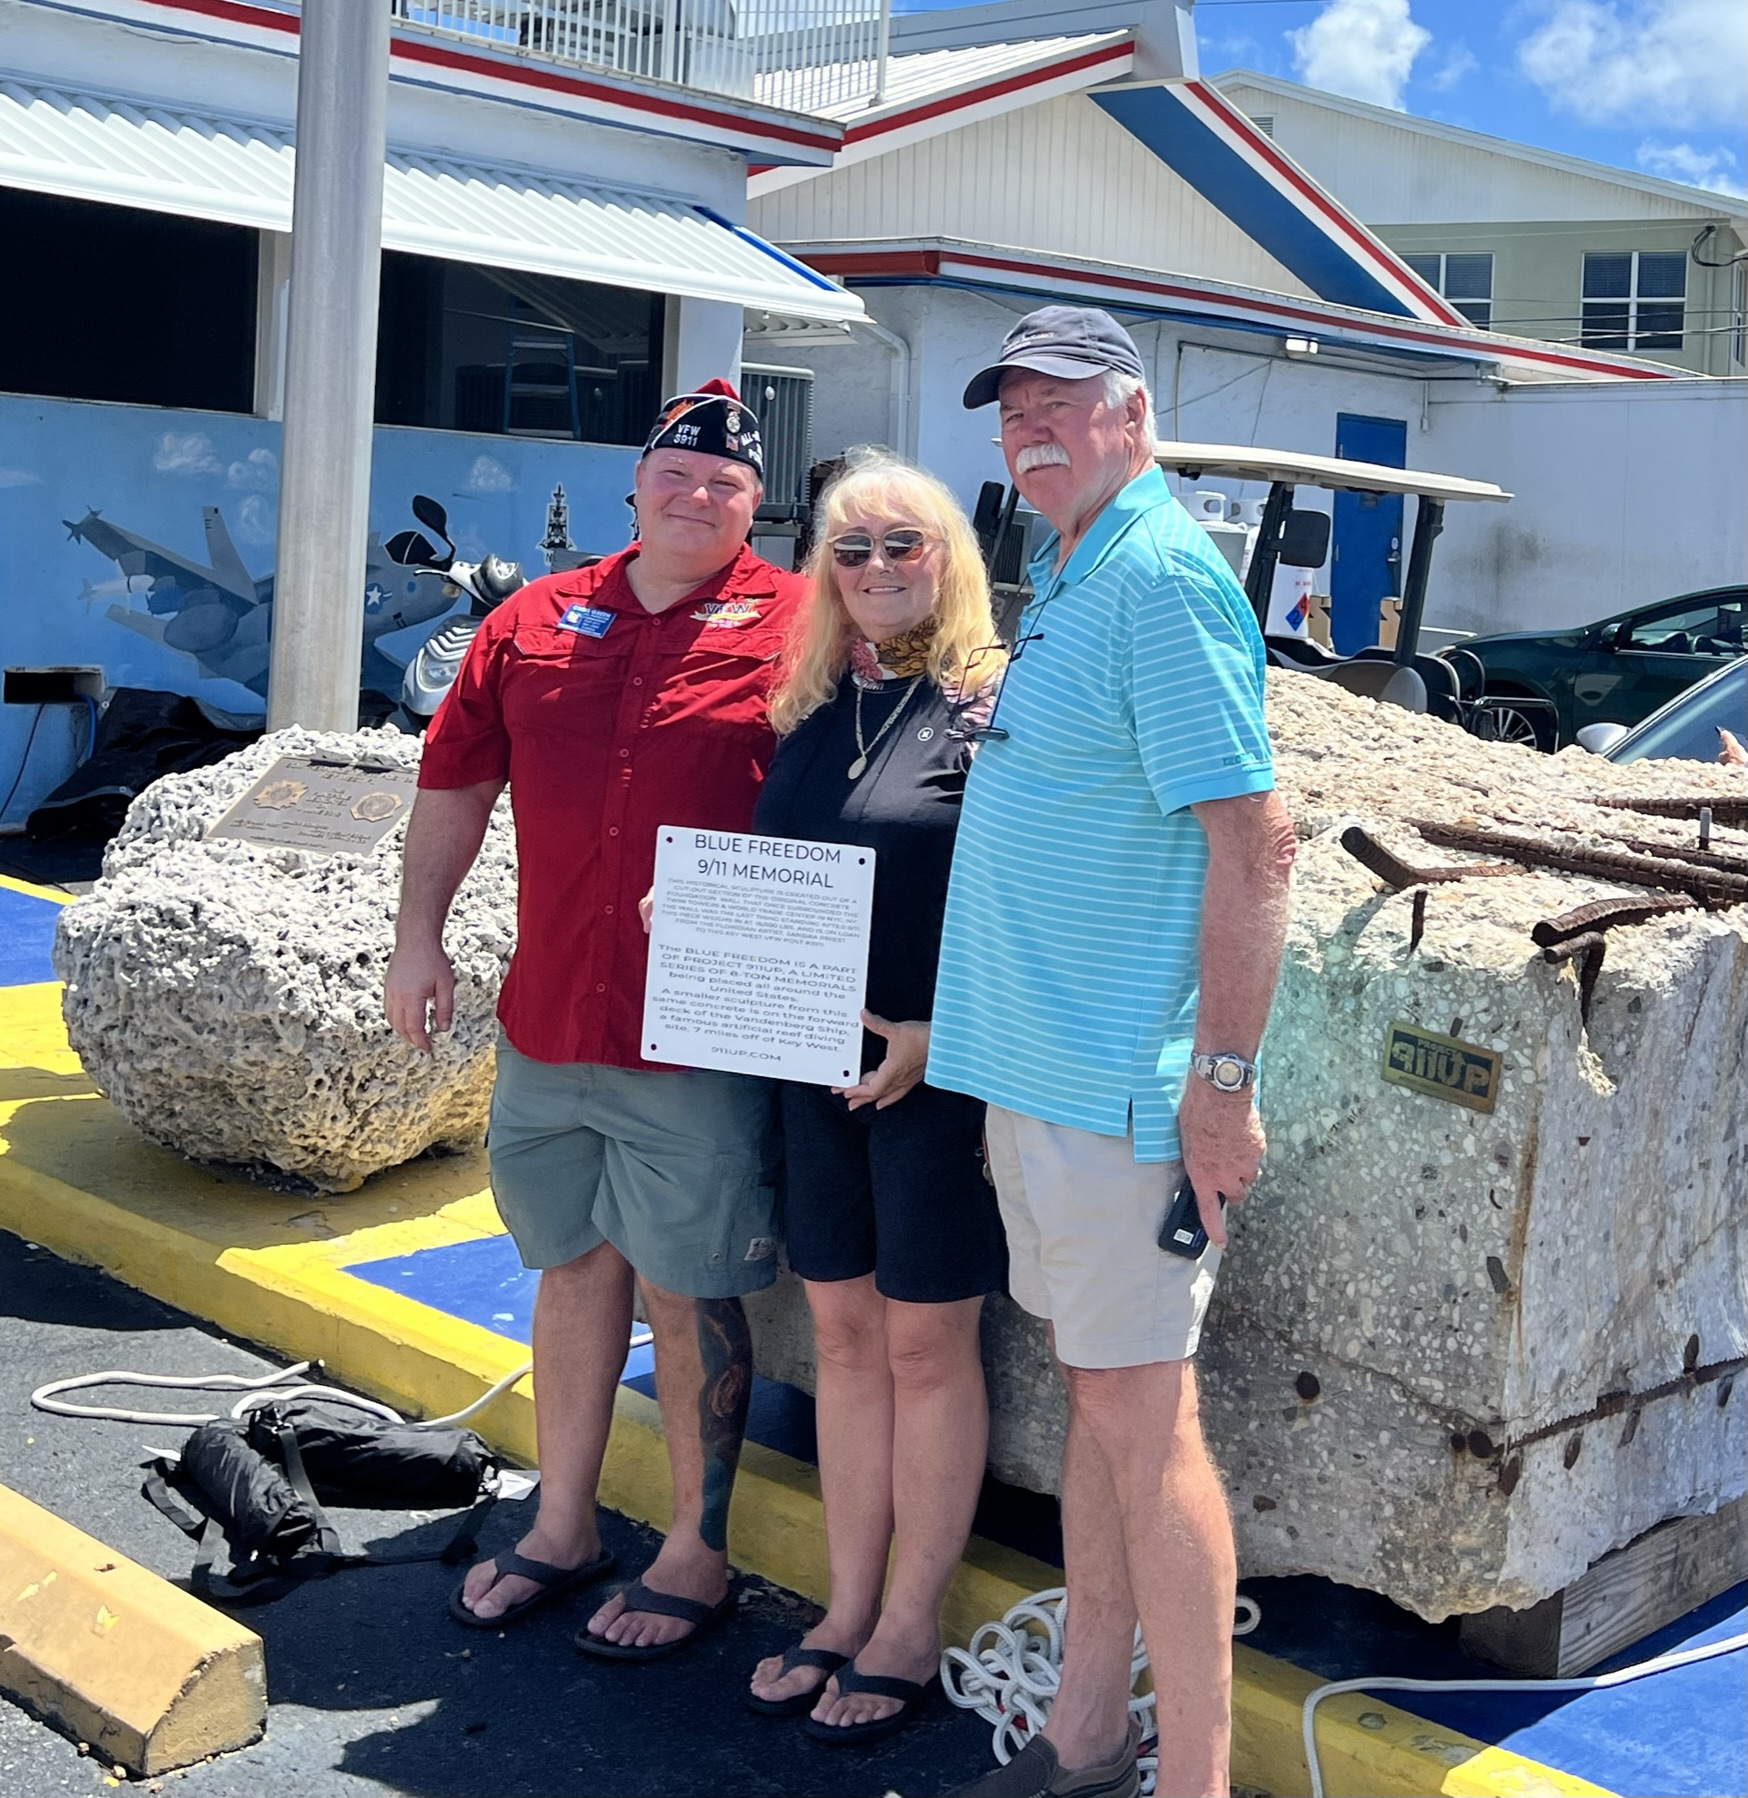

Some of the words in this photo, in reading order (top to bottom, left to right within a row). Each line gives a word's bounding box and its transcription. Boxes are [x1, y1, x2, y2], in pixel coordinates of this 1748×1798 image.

[673, 434, 698, 447] 3911
[677, 423, 701, 436] VFW
[695, 834, 742, 852] BLUE
[748, 840, 841, 863] FREEDOM
[697, 857, 726, 877] 9/11
[732, 862, 835, 889] MEMORIAL
[686, 880, 728, 888] HISTORICAL
[731, 885, 773, 894] SCULPTURE
[785, 891, 820, 899] CREATED
[667, 891, 716, 900] FOUNDATION
[787, 905, 841, 915] SURROUNDED
[727, 904, 756, 912] WORLD
[785, 911, 815, 919] CENTER
[770, 896, 805, 904] ORIGINAL
[808, 900, 849, 909] CONCRETE
[781, 918, 819, 926] STANDING
[658, 944, 681, 952] The
[685, 947, 719, 957] BLUE
[723, 952, 790, 966] FREEDOM
[822, 964, 856, 974] PART
[683, 955, 742, 968] PROJECT
[801, 970, 855, 983] LIMITED
[660, 961, 704, 972] SERIES
[708, 967, 726, 975] OF
[774, 976, 856, 992] MEMORIALS
[669, 971, 705, 982] being
[709, 976, 751, 988] placed
[773, 985, 820, 996] around
[823, 991, 845, 999] the
[709, 985, 752, 996] United
[652, 996, 686, 1005] same
[690, 1000, 746, 1012] concrete
[783, 1012, 804, 1020] the
[808, 1015, 859, 1028] forward
[673, 989, 720, 1001] smaller
[724, 995, 784, 1009] sculpture
[788, 1004, 819, 1014] from
[822, 1008, 847, 1018] this
[659, 1004, 691, 1013] deck
[710, 1011, 731, 1019] the
[734, 1014, 814, 1031] Vandenberg
[670, 1014, 718, 1026] famous
[721, 1021, 772, 1033] artificial
[776, 1028, 801, 1037] reef
[804, 1032, 845, 1044] diving
[704, 1027, 738, 1037] miles
[778, 1037, 802, 1047] Key
[711, 1046, 781, 1061] 911UP.COM
